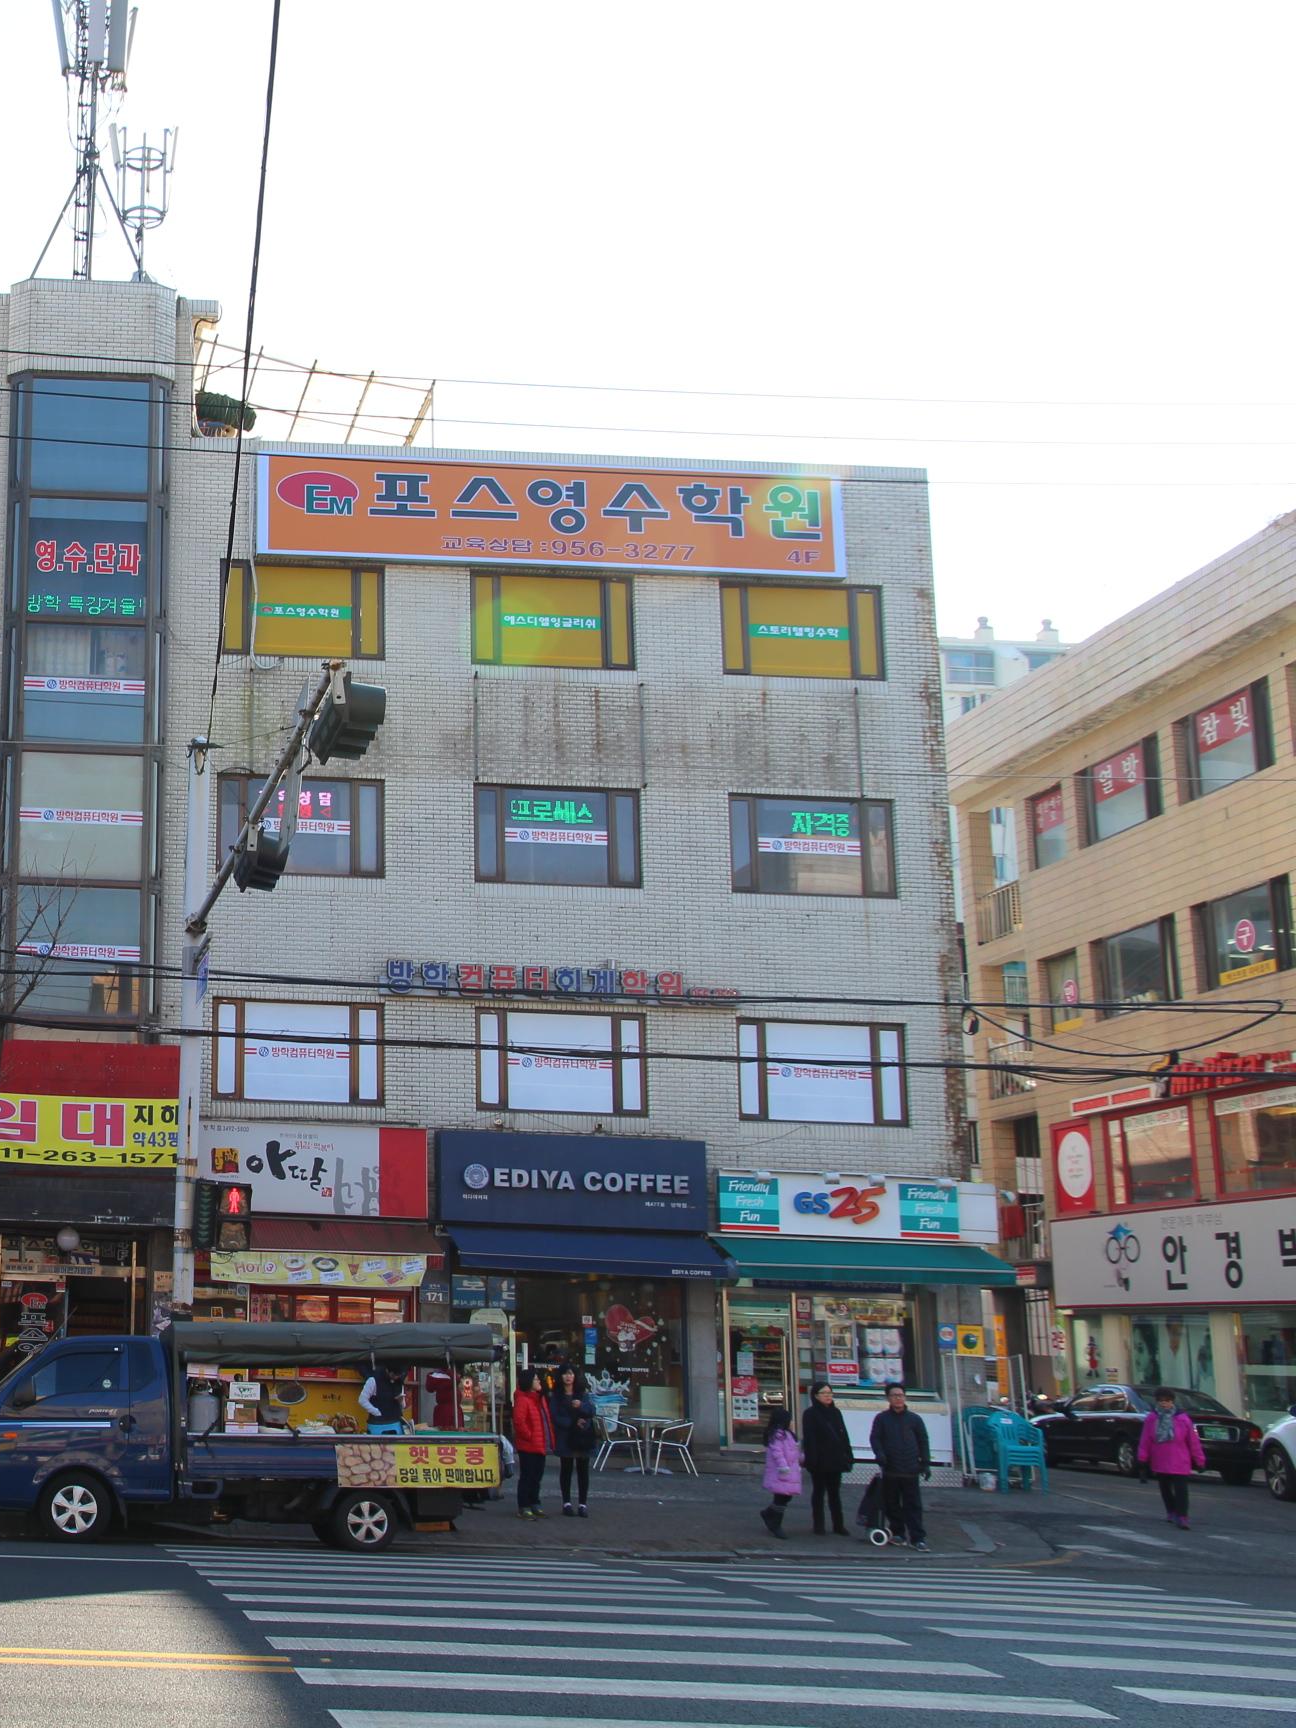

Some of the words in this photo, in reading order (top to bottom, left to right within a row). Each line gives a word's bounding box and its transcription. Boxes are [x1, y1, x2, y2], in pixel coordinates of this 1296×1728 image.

[368, 471, 824, 541] 포스영수학원
[440, 535, 533, 553] 교육상담
[785, 549, 820, 564] 4F
[273, 605, 340, 619] 포스영수학원
[757, 624, 840, 639] 스토리텔링수학
[58, 679, 121, 692] 방학컴퓨터학원
[55, 809, 119, 823] 방학컴퓨터학원
[791, 811, 850, 837] 자격증
[530, 831, 593, 844] 방학컴퓨터학원
[783, 839, 847, 854] 방학컴퓨터학원
[53, 945, 116, 959] 방학컴퓨터학원
[386, 958, 684, 1004] 방학컴퓨터회계학원
[271, 1046, 335, 1060] 방학컴퓨터학원
[533, 1057, 598, 1070] 방학컴퓨터학원
[792, 1067, 857, 1081] 방학컴퓨터학원
[493, 1167, 576, 1190] EDIYA
[583, 1171, 690, 1195] COFFEE
[728, 1180, 770, 1194] Friendly
[735, 1195, 764, 1208] Fresh
[907, 1187, 949, 1202] Friendly
[793, 1186, 886, 1225] GS25
[915, 1203, 944, 1215] Fresh
[740, 1211, 760, 1222] Fun
[920, 1218, 940, 1230] Fun
[426, 1291, 443, 1302] 171
[408, 1446, 485, 1465] 햇땅콩
[399, 1468, 419, 1483] 당일
[422, 1468, 442, 1483] 볶아
[445, 1468, 497, 1484] 판매합니다.
